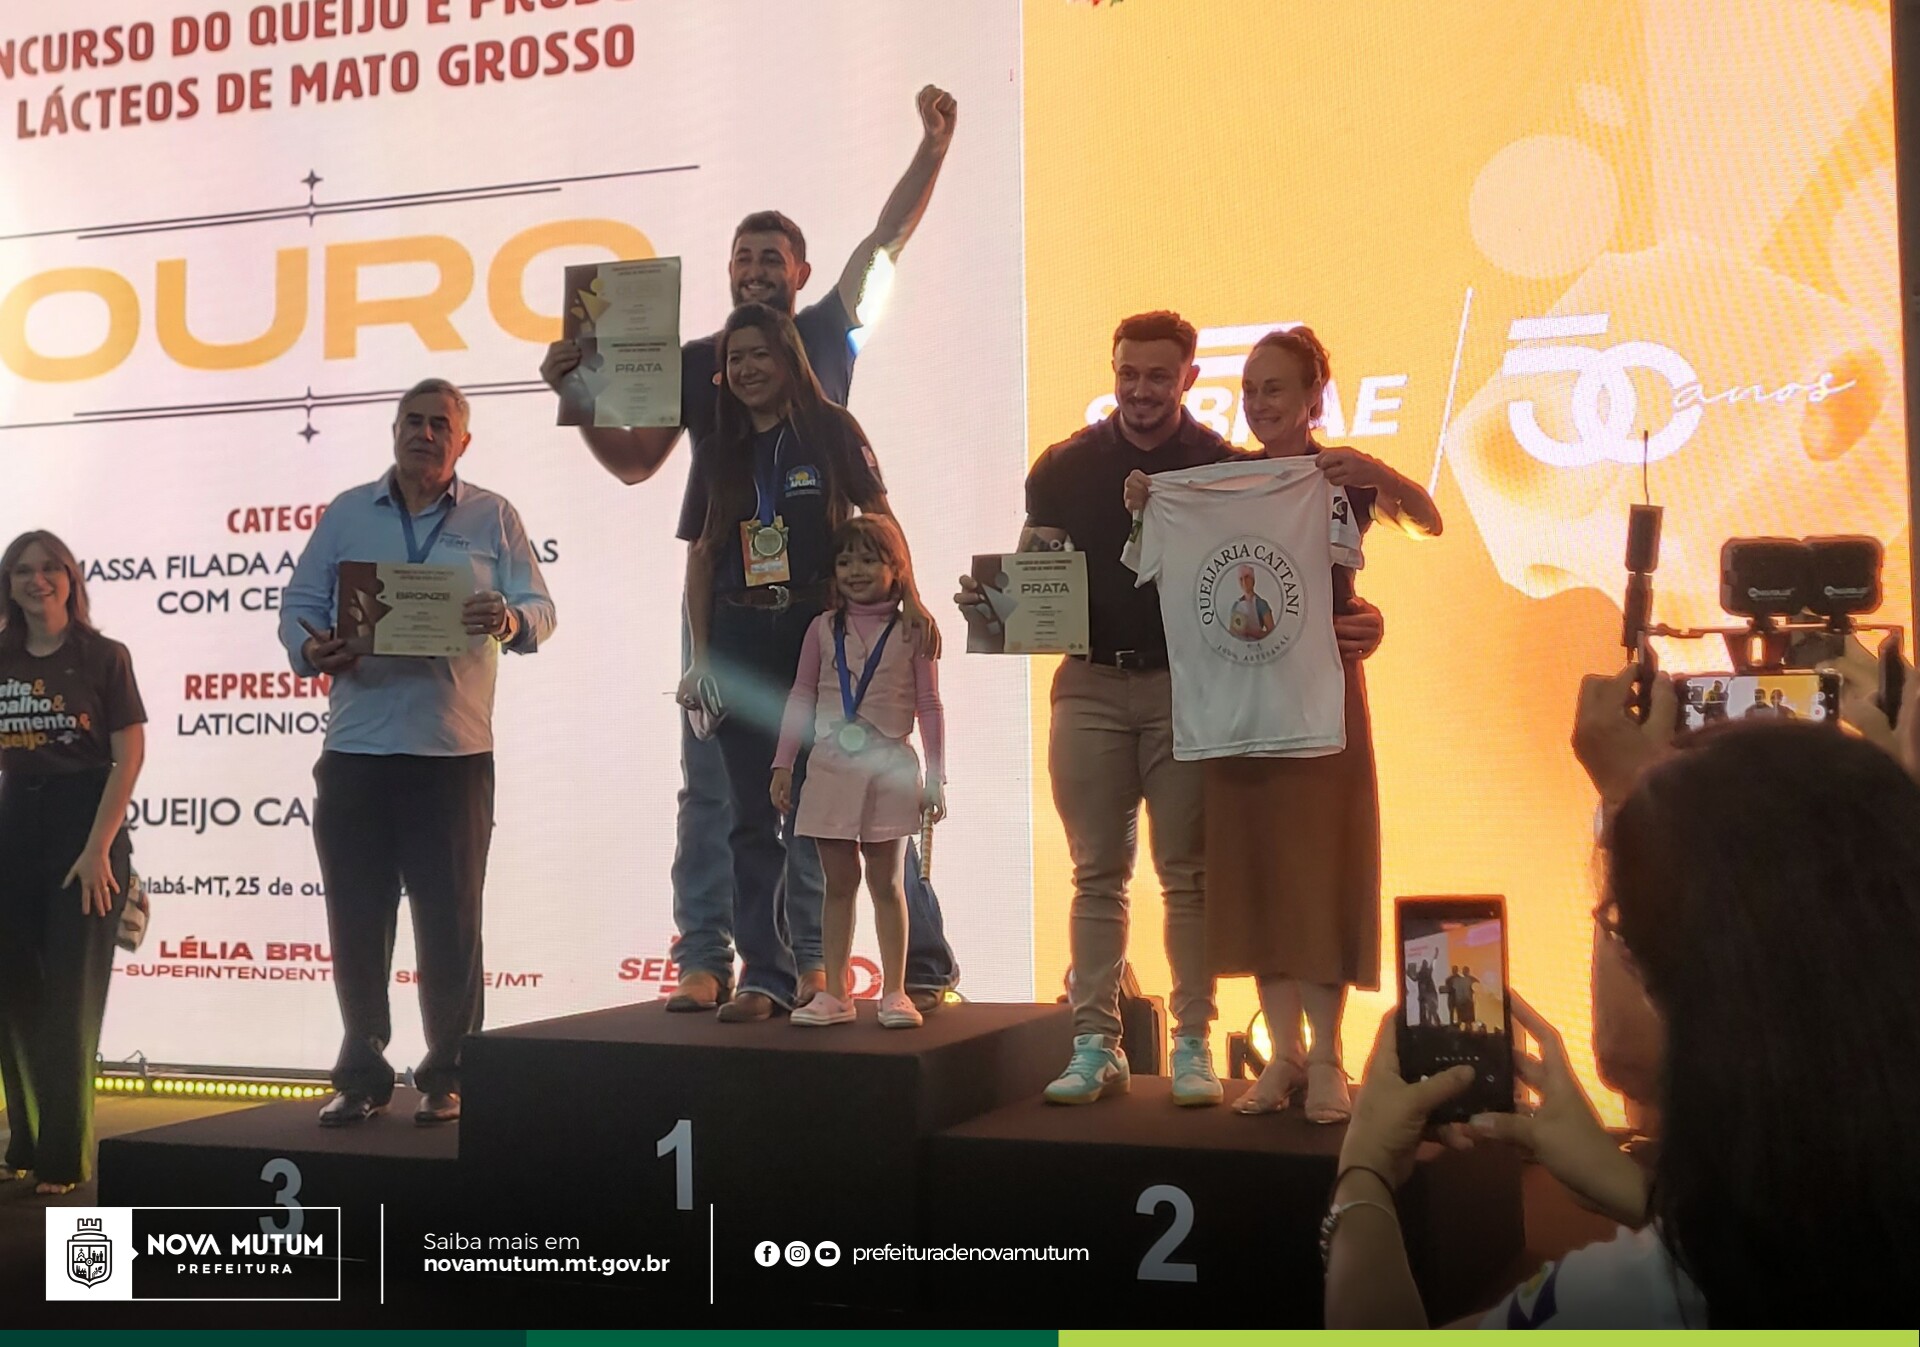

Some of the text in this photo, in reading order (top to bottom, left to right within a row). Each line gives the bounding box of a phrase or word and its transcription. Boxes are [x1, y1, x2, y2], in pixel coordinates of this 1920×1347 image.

[172, 11, 231, 56] DO
[249, 0, 409, 47] QUEIJO
[17, 24, 635, 139] LÁCTEOS DE MATO GROSSO
[0, 218, 656, 384] OURO
[615, 362, 663, 373] PRATA
[1503, 313, 1857, 467] 50 anos
[227, 504, 330, 533] CATEG
[167, 552, 270, 579] FILADA
[395, 591, 450, 601] BRONZE
[1020, 582, 1070, 594] PRATA
[1200, 544, 1300, 626] QUEIJARIA CATTANI
[157, 588, 229, 614] COM
[235, 877, 260, 895] 25
[268, 877, 293, 896] de
[160, 936, 334, 962] LÉLIA BRU
[126, 964, 331, 981] SUPERINTENDENT
[655, 1119, 694, 1211] 1
[258, 1157, 305, 1243] 3
[1135, 1184, 1198, 1283] 2
